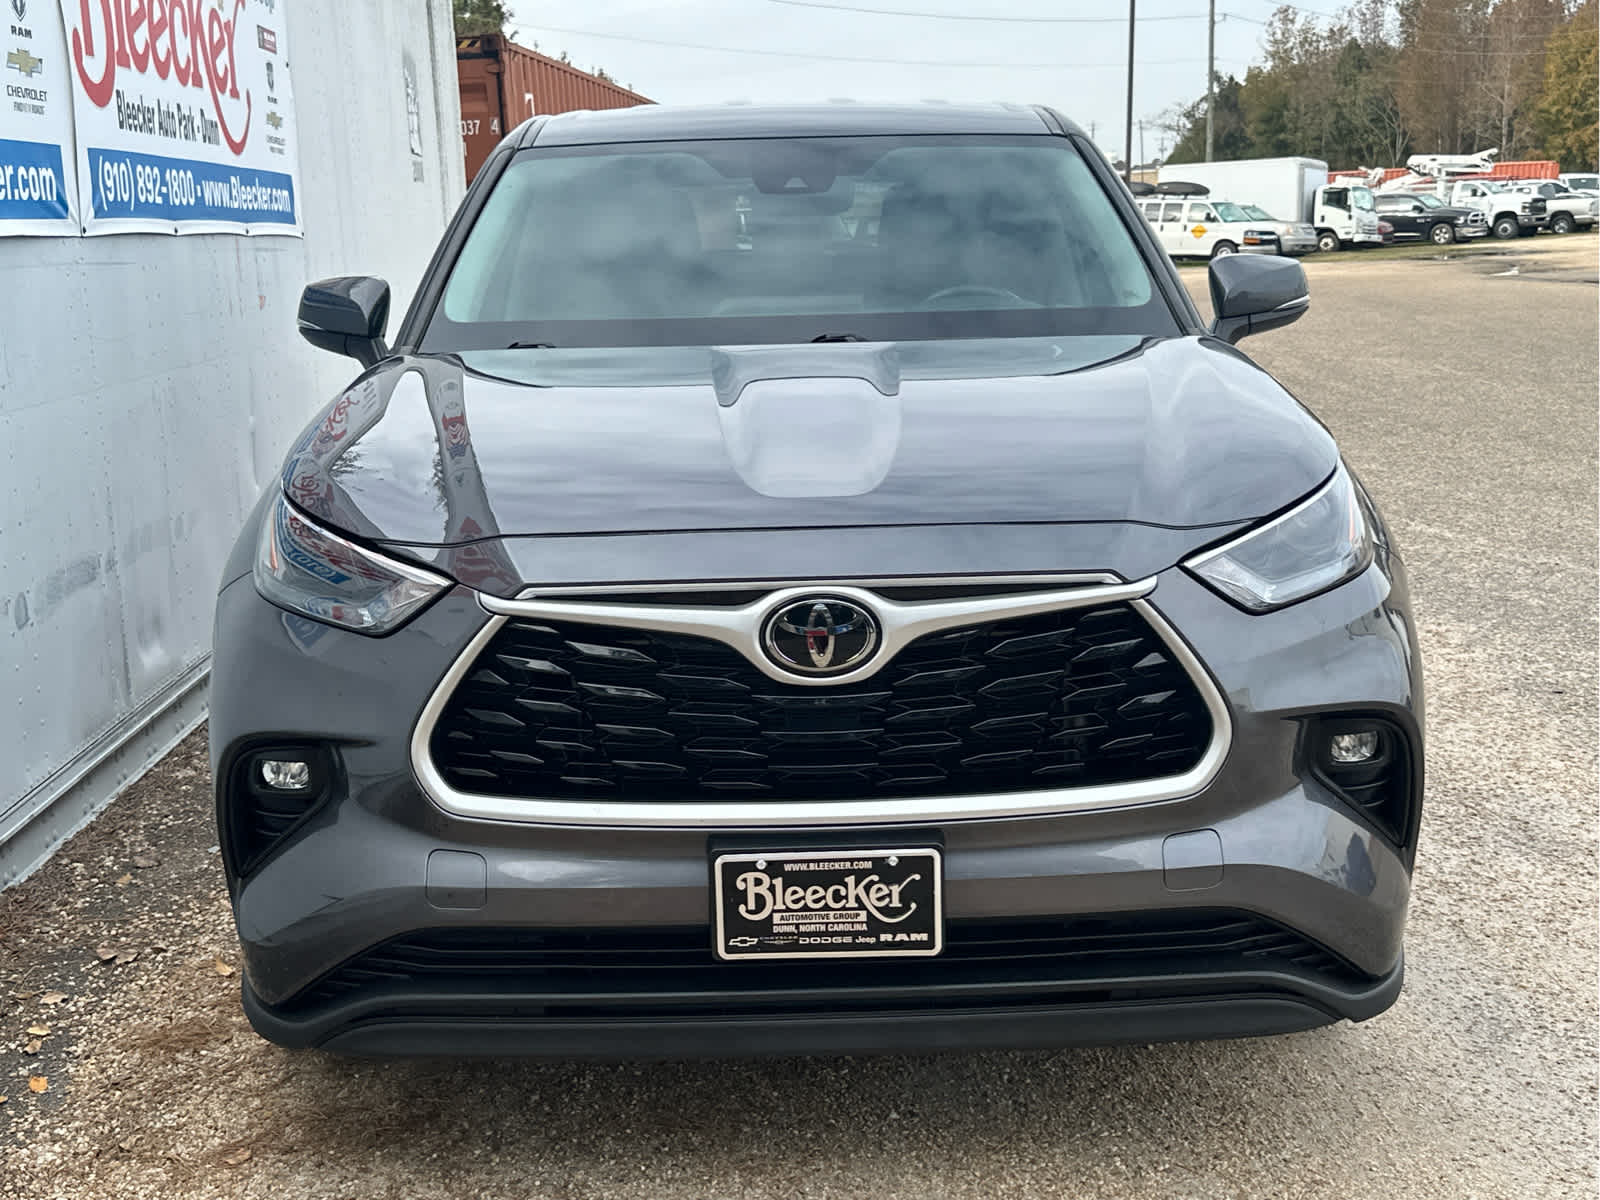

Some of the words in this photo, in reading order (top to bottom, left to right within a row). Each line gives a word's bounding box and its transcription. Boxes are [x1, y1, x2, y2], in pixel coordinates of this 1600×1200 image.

[11, 25, 33, 39] RAM
[6, 84, 48, 102] CHEVROLET
[115, 89, 156, 135] Bleecker
[157, 98, 177, 139] Auto
[176, 102, 197, 142] Park
[99, 155, 135, 211] (910)
[136, 165, 195, 206] 892-1800
[201, 175, 291, 213] www.Bleecker.com
[784, 861, 872, 872] WWW.BLEECKER.COM
[736, 872, 921, 923] Bleecker
[779, 913, 831, 921] AUTOMOTIVE
[833, 912, 860, 920] GROUP
[772, 924, 798, 934] DUNN,
[799, 923, 826, 932] NORTH
[828, 922, 868, 932] CAROLINA
[799, 936, 853, 944] DODGE
[855, 936, 876, 944] Jeep
[879, 933, 928, 941] RAM
